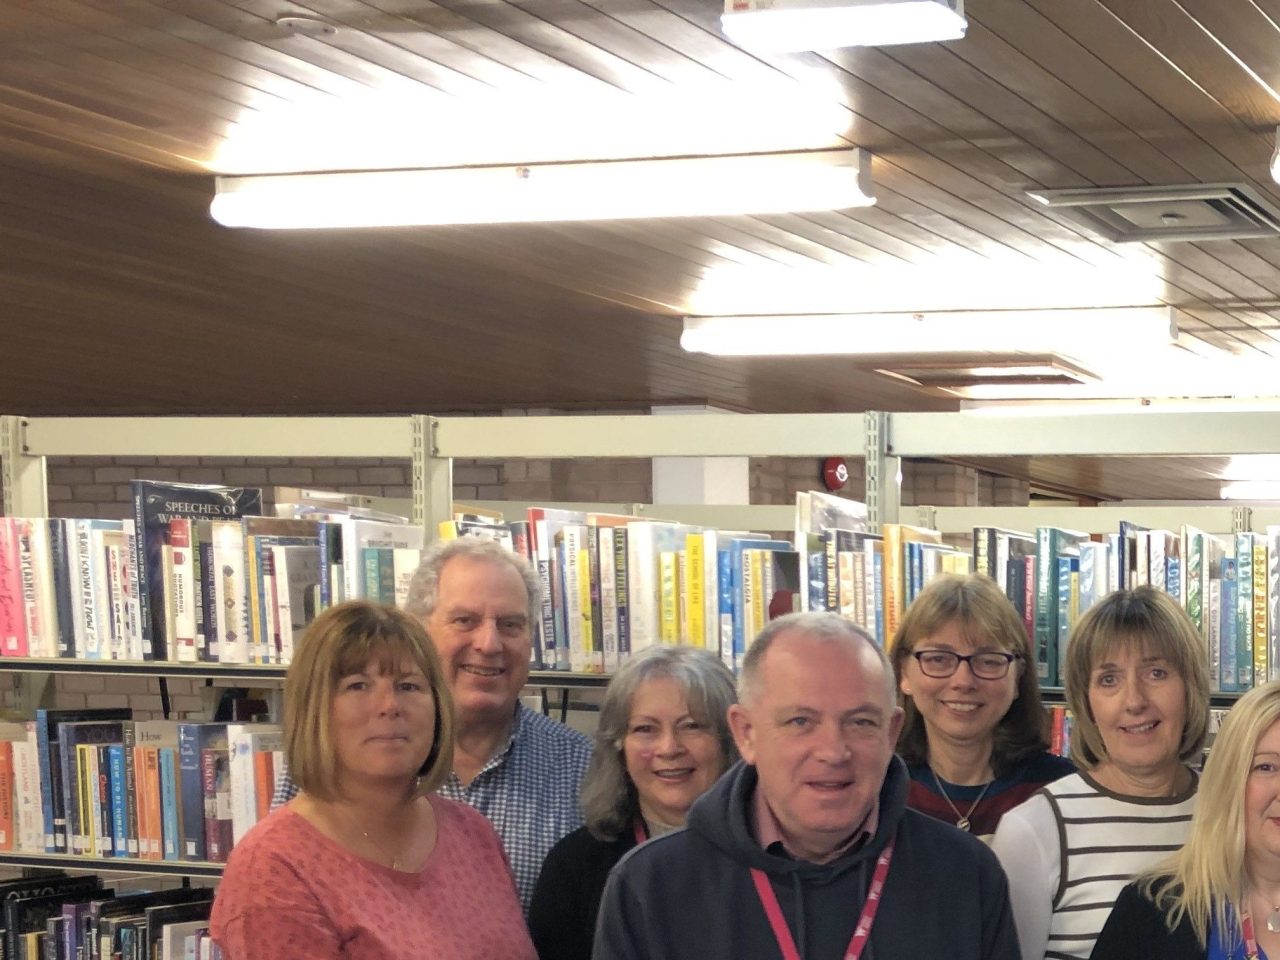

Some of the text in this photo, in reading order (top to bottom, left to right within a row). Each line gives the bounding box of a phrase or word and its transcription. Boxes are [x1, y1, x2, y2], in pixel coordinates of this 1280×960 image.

[165, 501, 220, 514] SPEECHES
[128, 535, 136, 571] MERCHANTS
[130, 580, 138, 599] TRUTH
[539, 562, 553, 642] PSYCHOMETRIC TESTS
[141, 730, 162, 742] How
[205, 754, 214, 790] HUMAN
[115, 782, 120, 792] TO
[115, 796, 121, 804] BE
